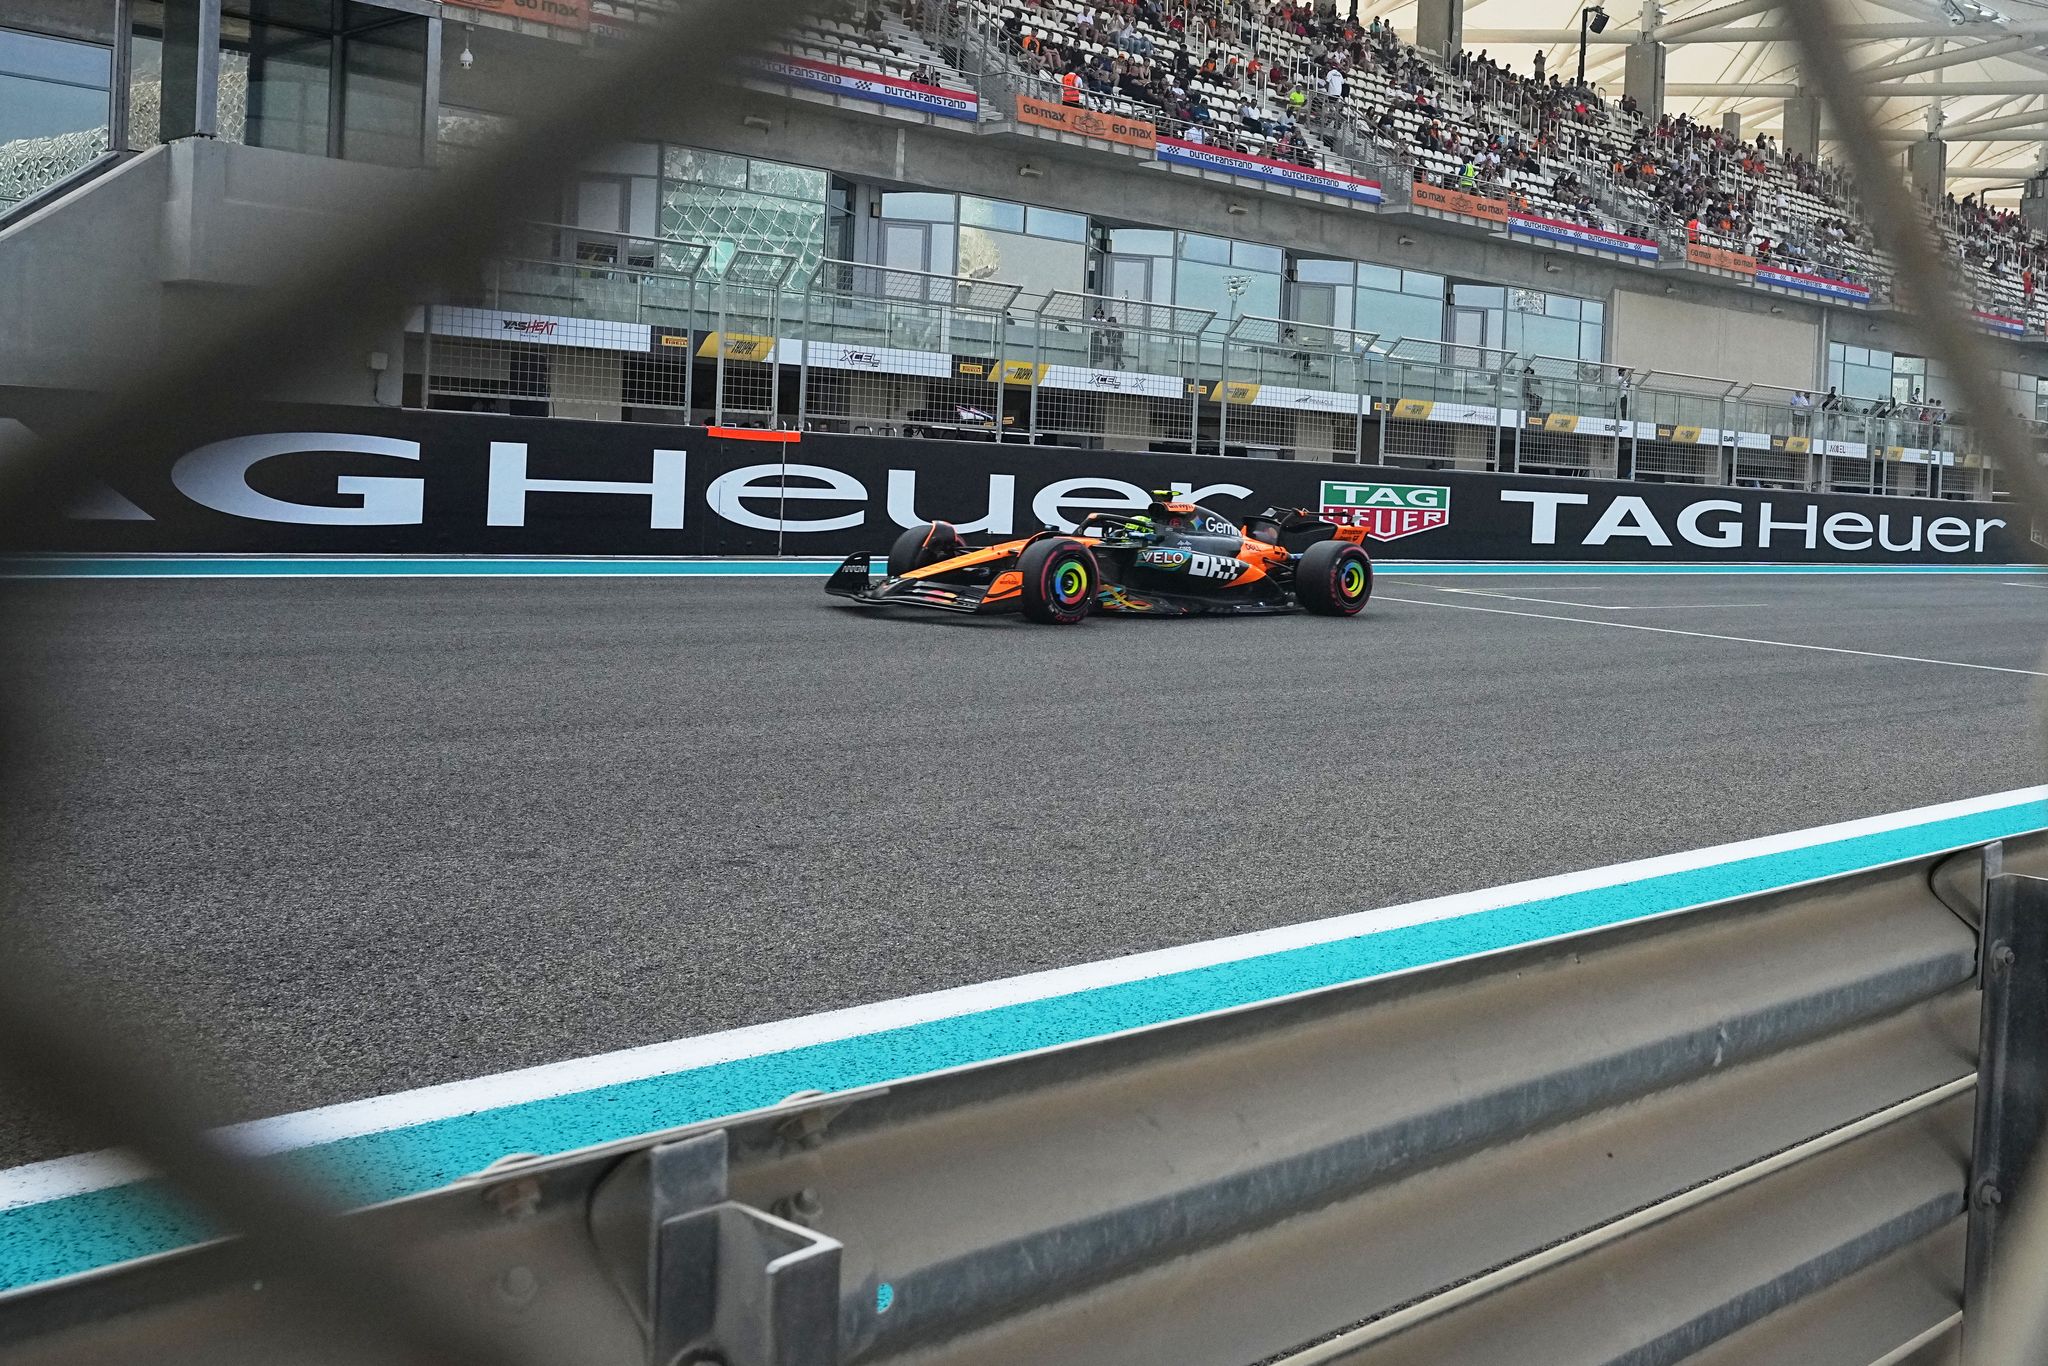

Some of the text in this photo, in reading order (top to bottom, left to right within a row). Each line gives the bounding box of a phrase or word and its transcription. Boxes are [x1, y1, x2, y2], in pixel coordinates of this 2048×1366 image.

[884, 85, 917, 101] DUTCH
[1023, 104, 1039, 116] GO
[1112, 123, 1127, 135] GO
[1189, 150, 1214, 163] DUTCH
[1282, 169, 1305, 181] DUTCH
[1524, 220, 1542, 230] DUTCH
[1333, 485, 1438, 507] TAG
[1328, 508, 1442, 537] HEUER
[1142, 551, 1184, 564] VELO
